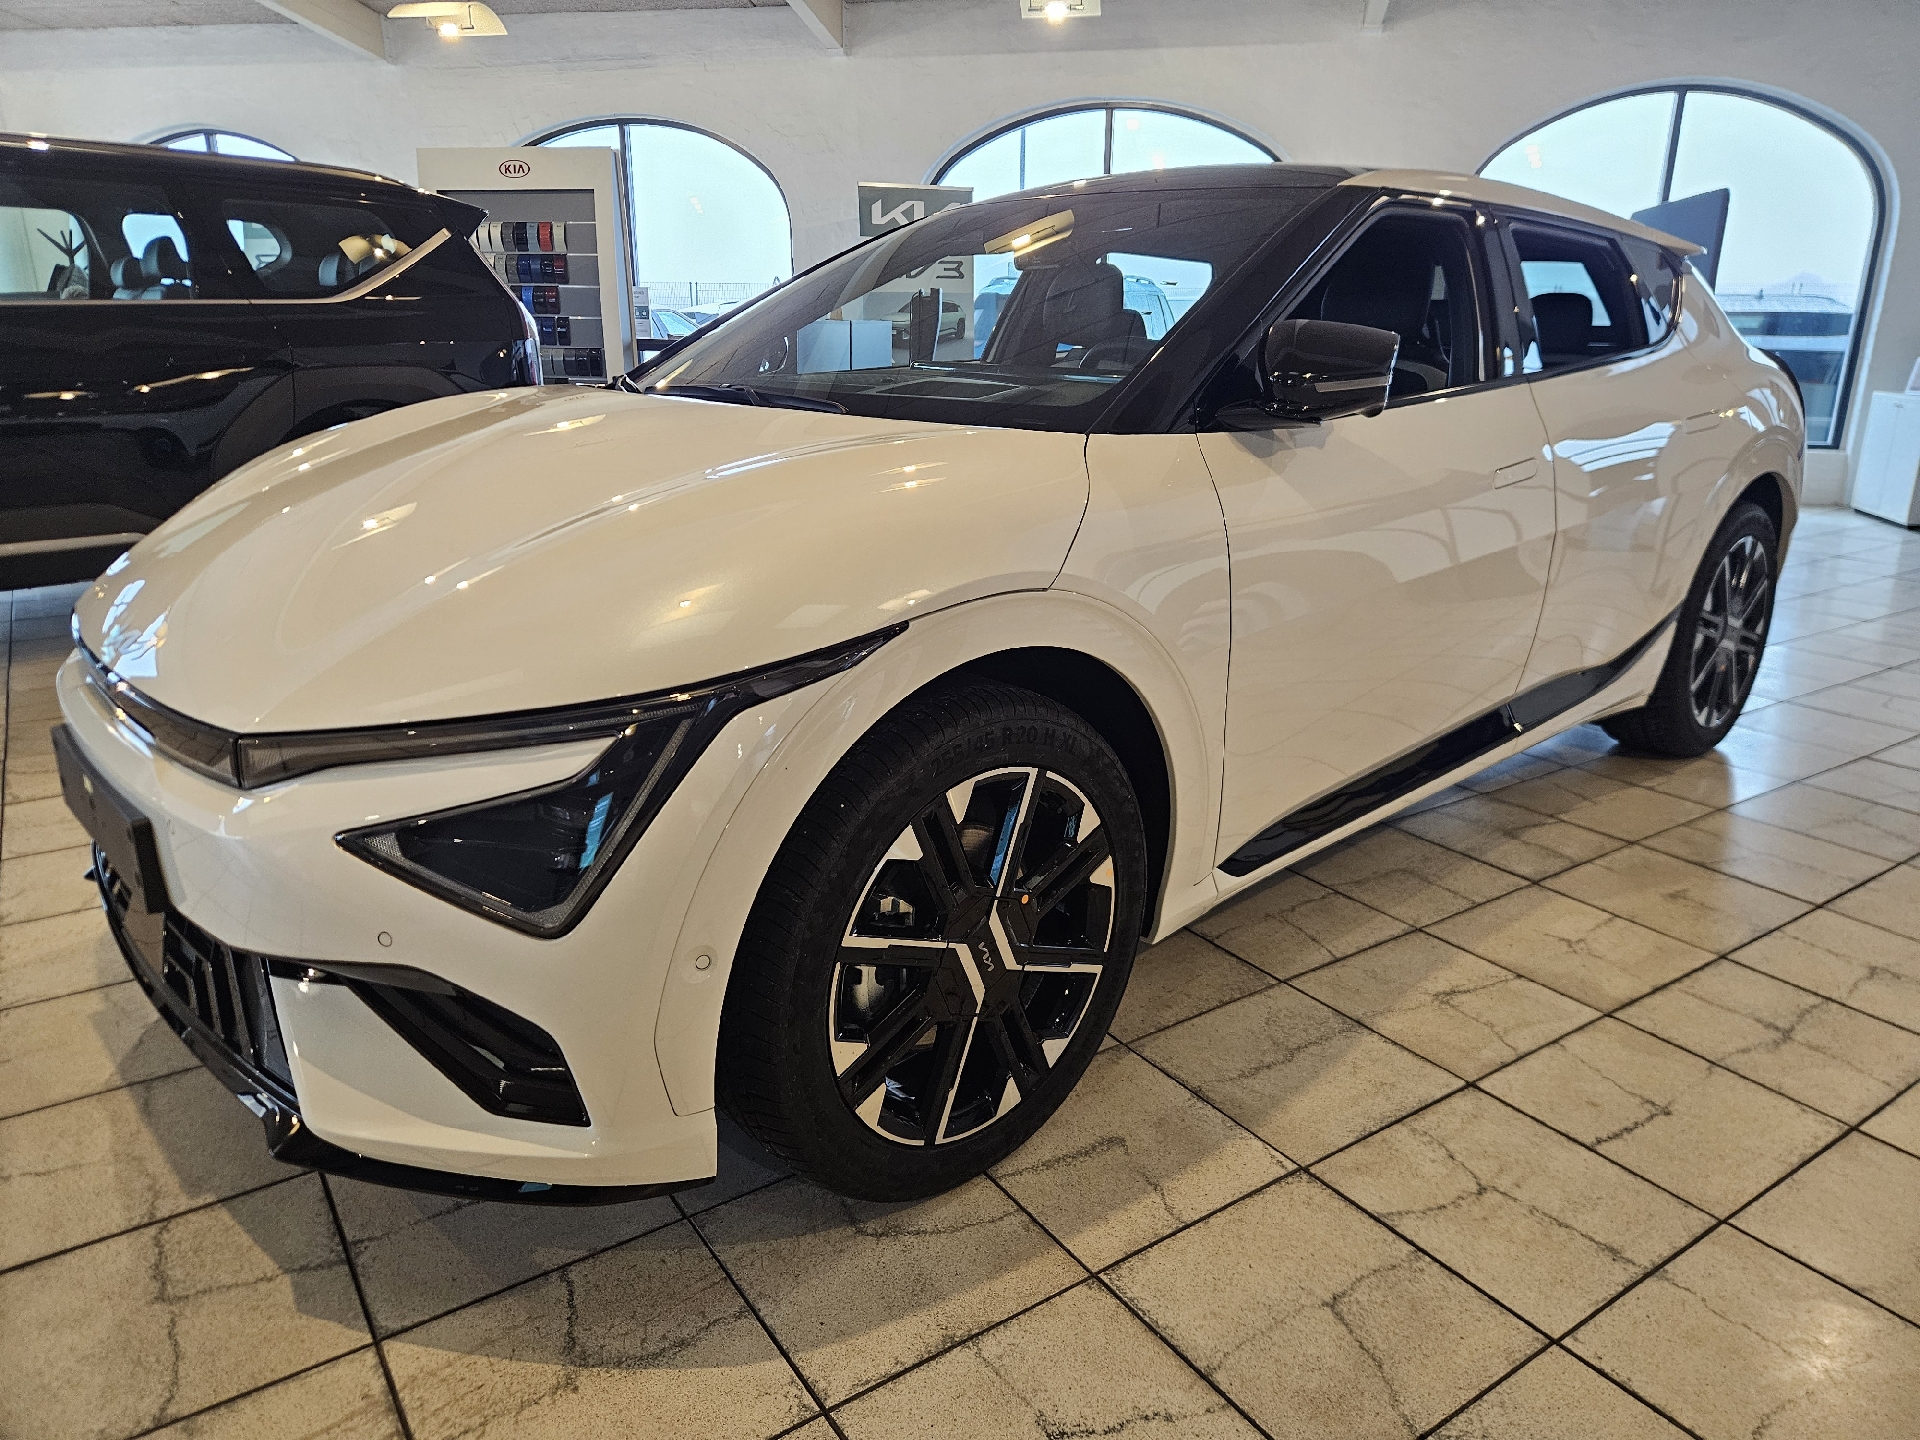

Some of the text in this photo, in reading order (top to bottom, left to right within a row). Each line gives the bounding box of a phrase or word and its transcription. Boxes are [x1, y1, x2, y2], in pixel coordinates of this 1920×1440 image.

[504, 164, 526, 175] KIA
[872, 199, 961, 225] KI
[899, 260, 965, 280] V3
